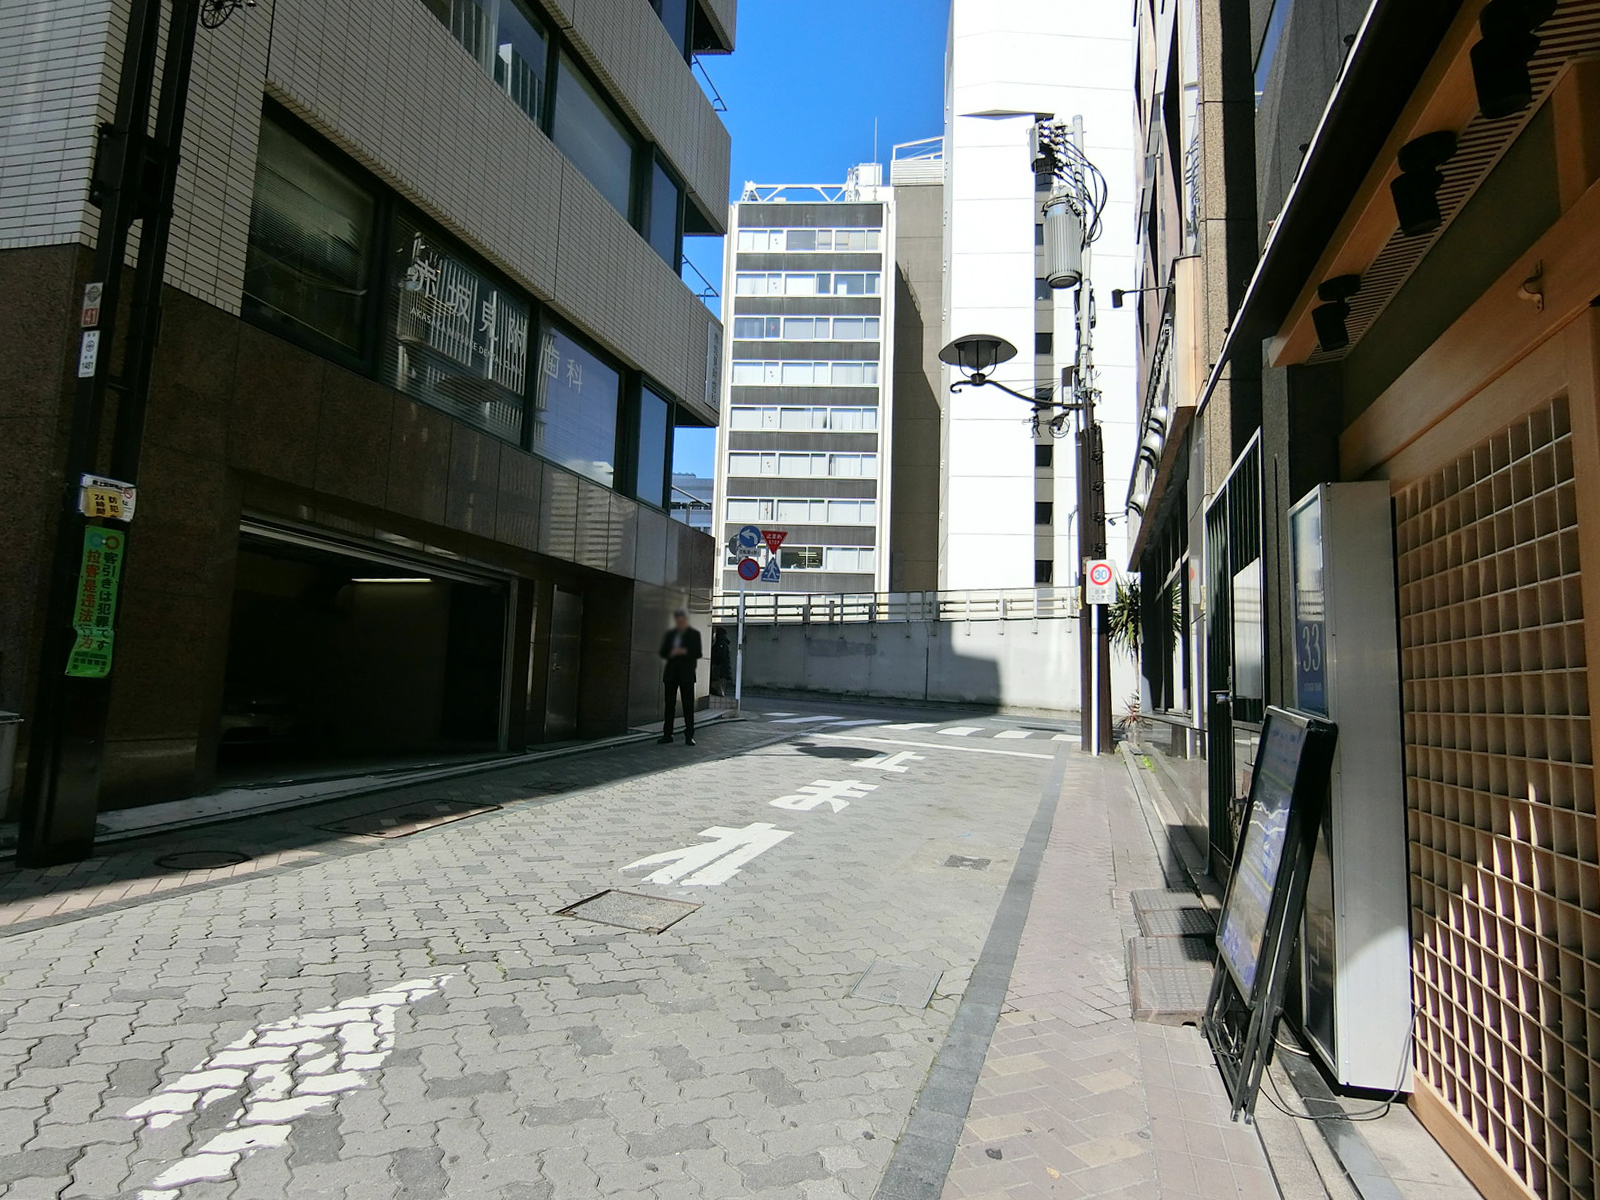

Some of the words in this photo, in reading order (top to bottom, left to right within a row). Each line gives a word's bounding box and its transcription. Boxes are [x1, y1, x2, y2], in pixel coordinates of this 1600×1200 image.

[85, 309, 97, 324] 41
[1094, 570, 1108, 580] 30
[96, 551, 118, 651] 客引きは犯罪です
[1302, 623, 1321, 672] 33
